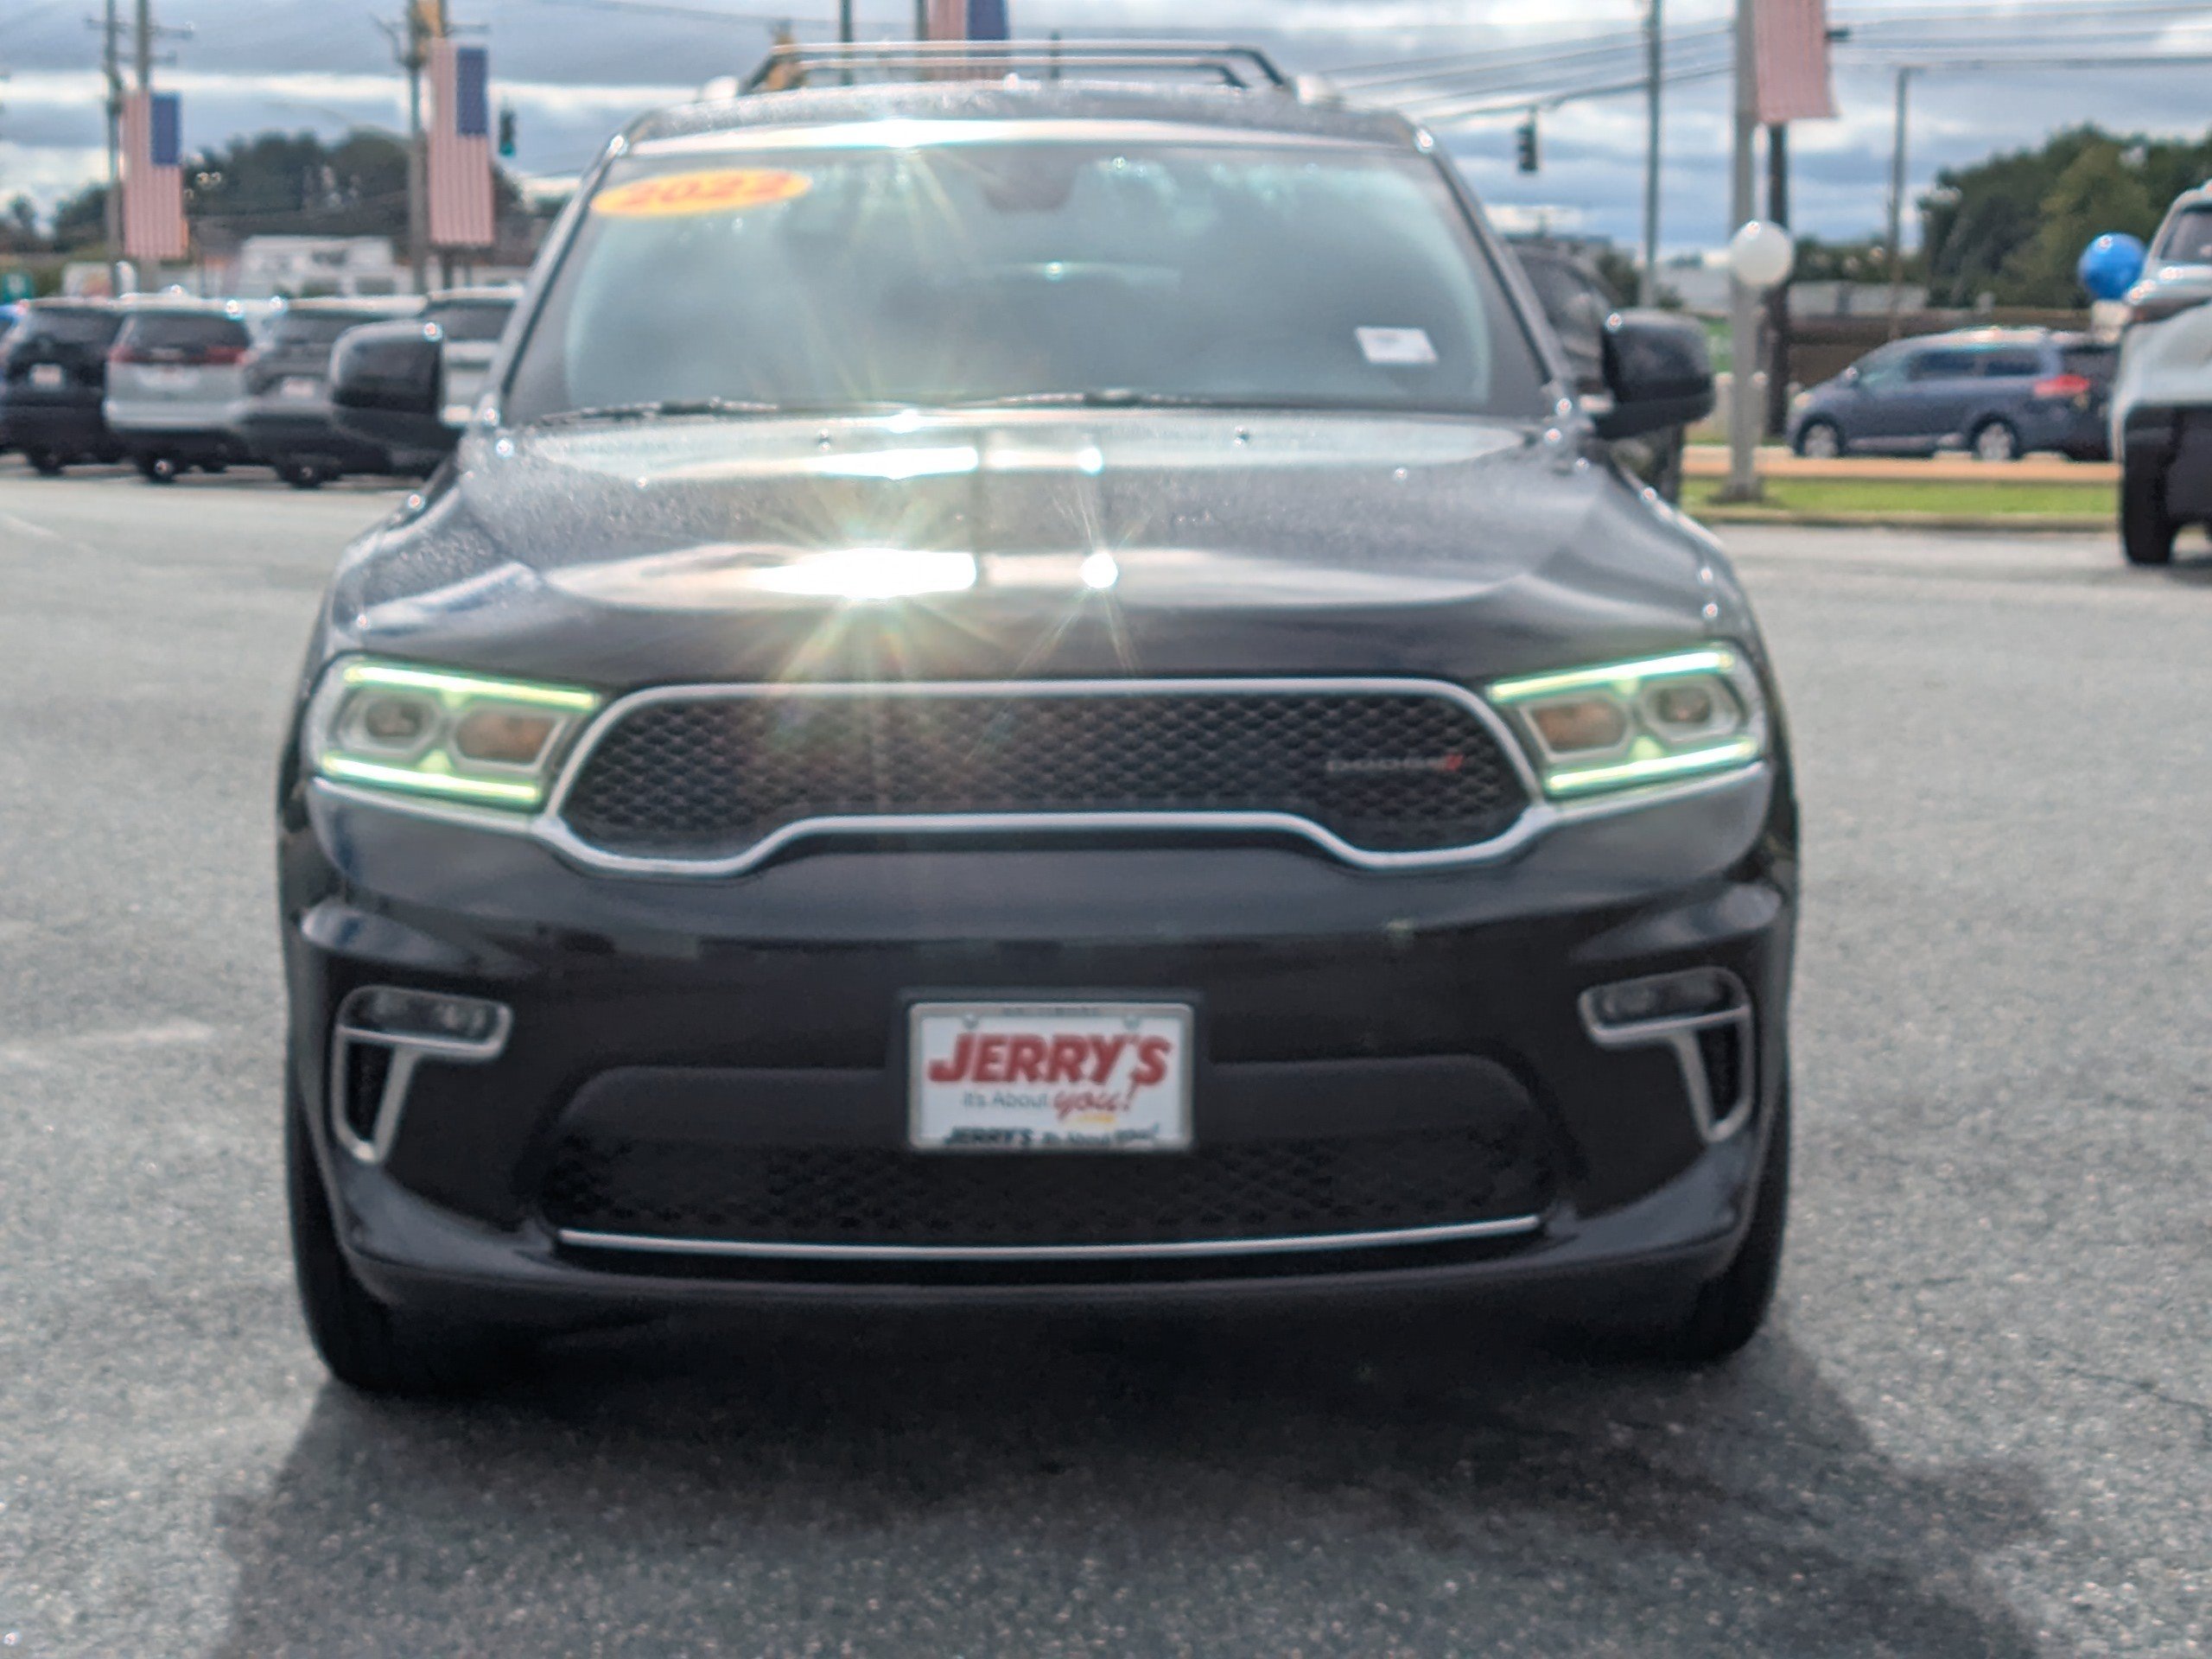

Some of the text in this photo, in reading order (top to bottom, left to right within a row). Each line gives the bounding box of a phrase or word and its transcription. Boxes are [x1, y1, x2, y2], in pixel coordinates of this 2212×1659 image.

[620, 171, 792, 205] 2022
[927, 1033, 1172, 1085] JERRY'S
[993, 1091, 1048, 1108] About
